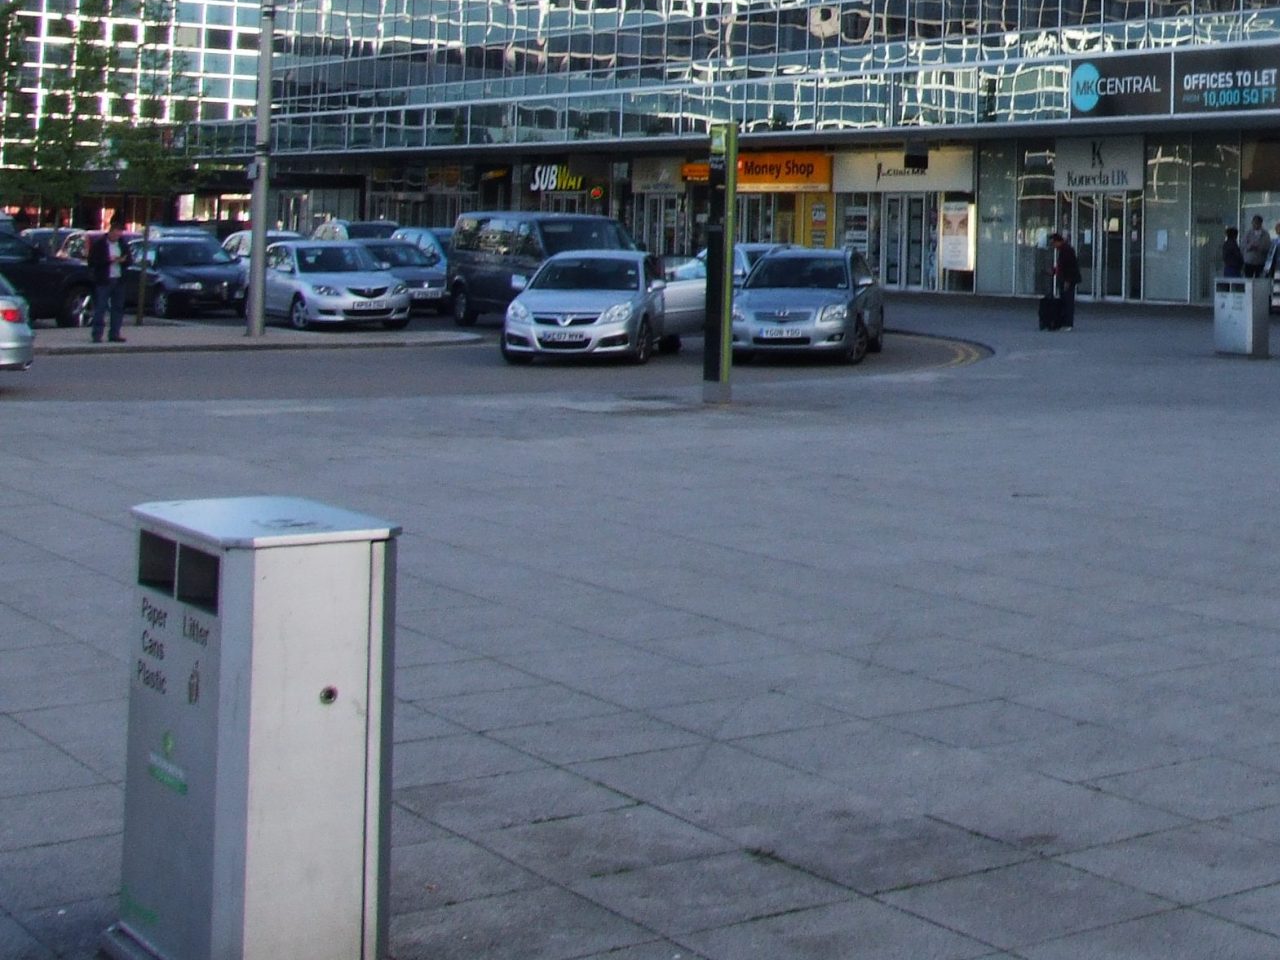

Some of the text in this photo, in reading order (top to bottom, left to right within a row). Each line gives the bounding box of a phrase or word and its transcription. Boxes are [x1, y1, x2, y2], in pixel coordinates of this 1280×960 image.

[1076, 75, 1161, 97] MK CENTRAL
[1183, 68, 1277, 90] OFFICES TO LET
[1202, 89, 1240, 108] 10,000
[1242, 88, 1258, 104] SQ
[1262, 87, 1276, 103] FT
[743, 159, 782, 179] Money
[785, 158, 815, 177] Shop
[1091, 141, 1105, 169] K
[530, 163, 584, 191] SUBWAY
[141, 596, 168, 630] Paper
[141, 629, 165, 661] Cans
[182, 615, 210, 649] Litter
[136, 657, 167, 695] Plastic
